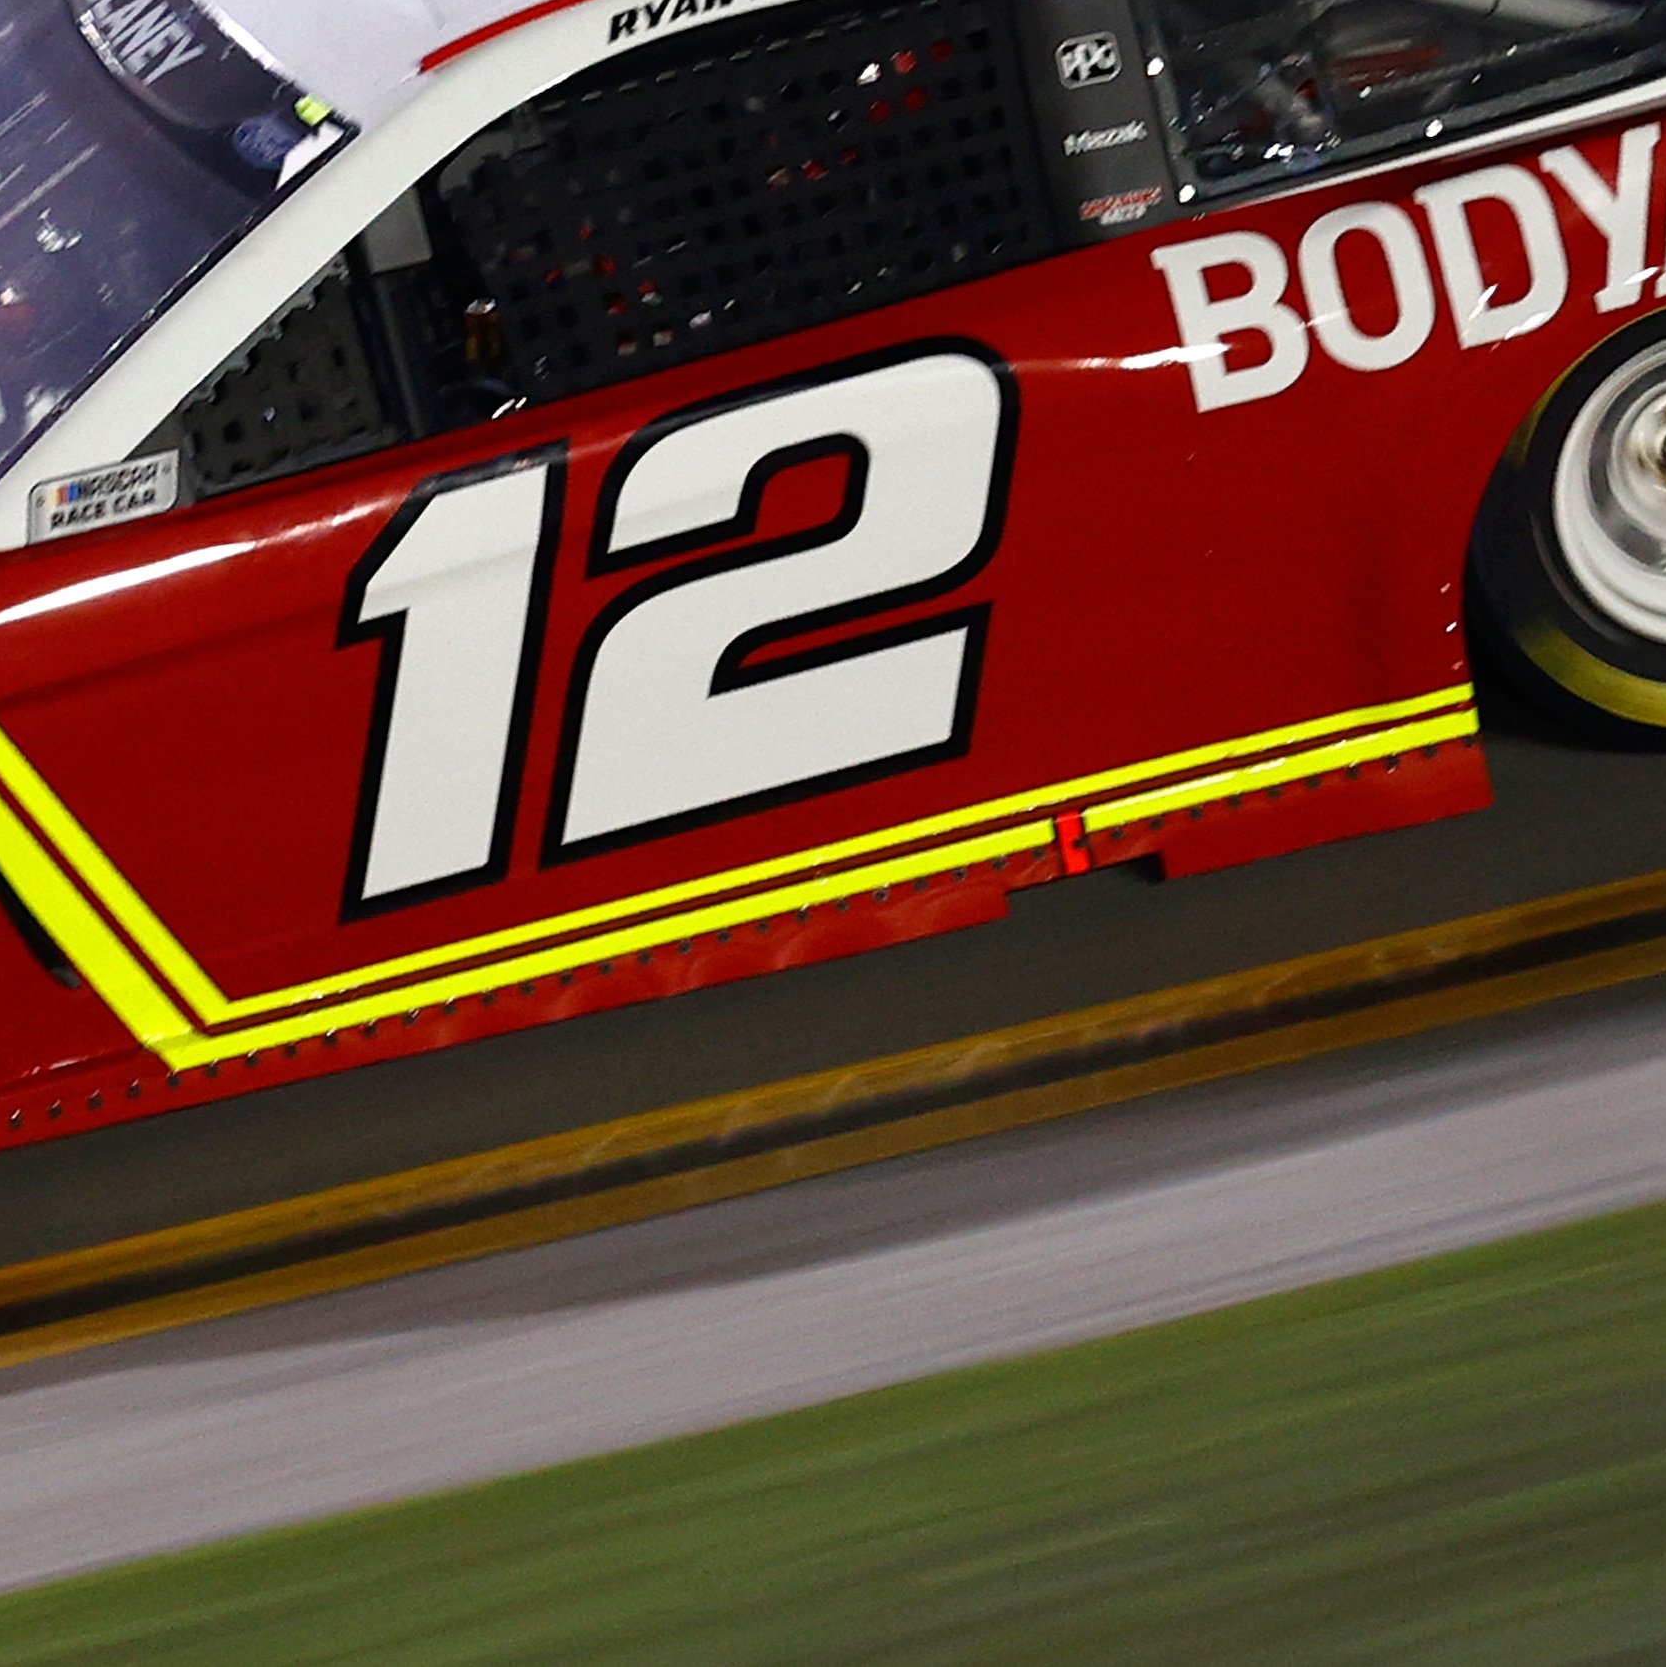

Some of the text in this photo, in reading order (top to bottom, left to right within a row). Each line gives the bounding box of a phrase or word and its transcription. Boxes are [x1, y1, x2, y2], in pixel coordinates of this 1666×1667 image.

[50, 488, 156, 529] RACE CAR
[333, 334, 1021, 924] 12
